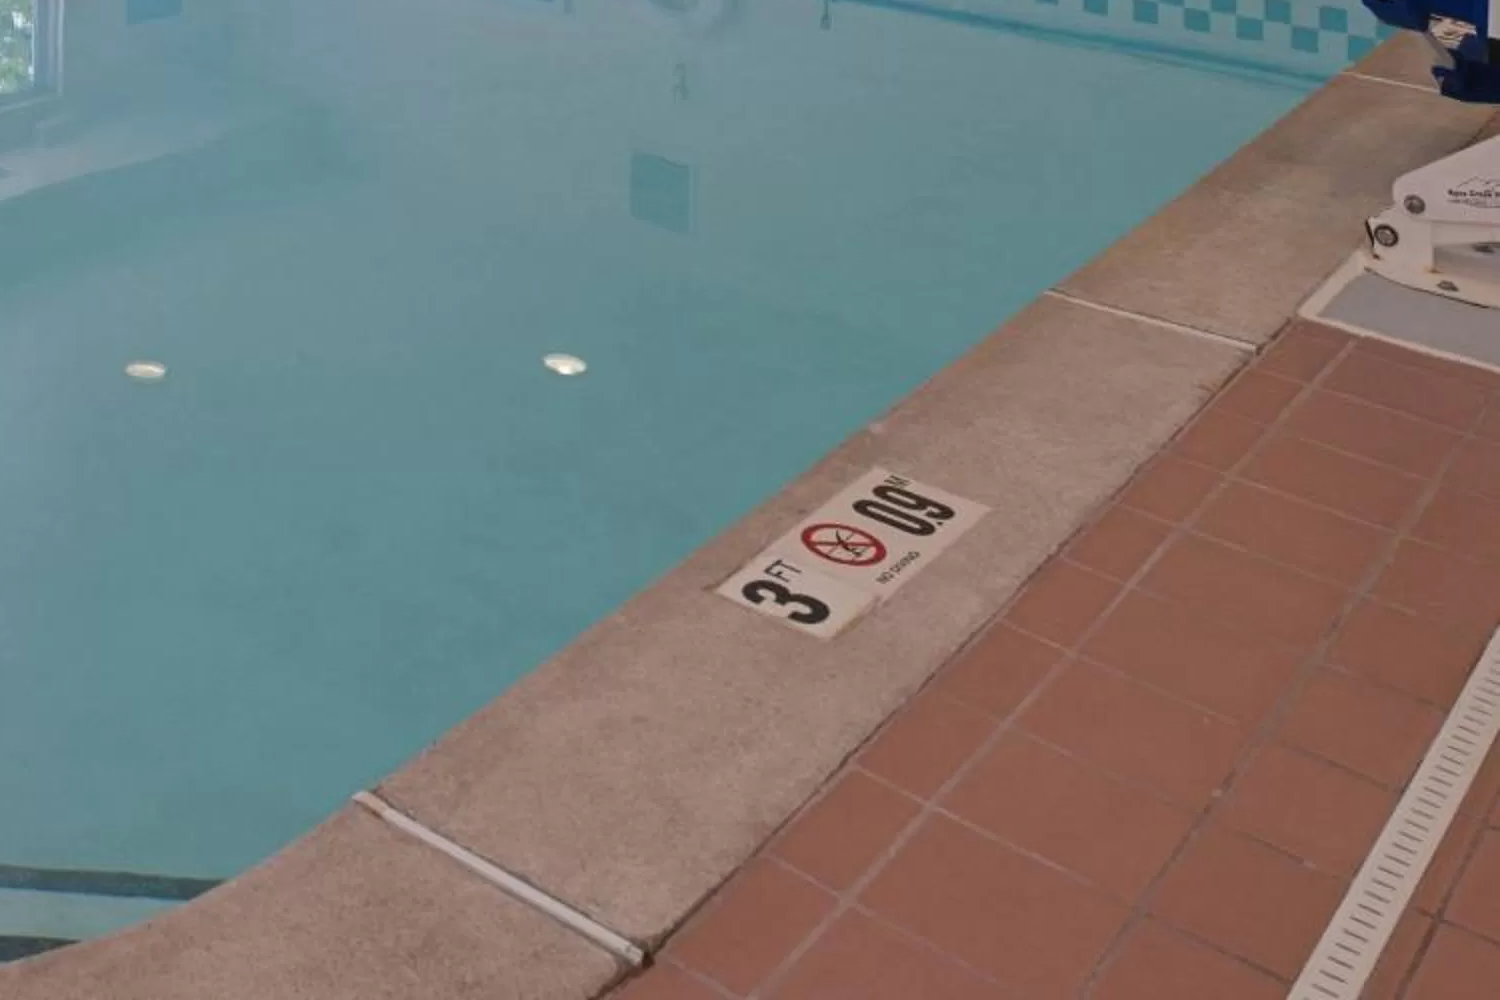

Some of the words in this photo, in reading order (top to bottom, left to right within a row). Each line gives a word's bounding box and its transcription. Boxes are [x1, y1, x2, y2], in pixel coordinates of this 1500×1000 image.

[763, 558, 803, 583] FT
[875, 572, 895, 585] NO
[891, 549, 921, 576] DIVING
[741, 579, 830, 625] 3
